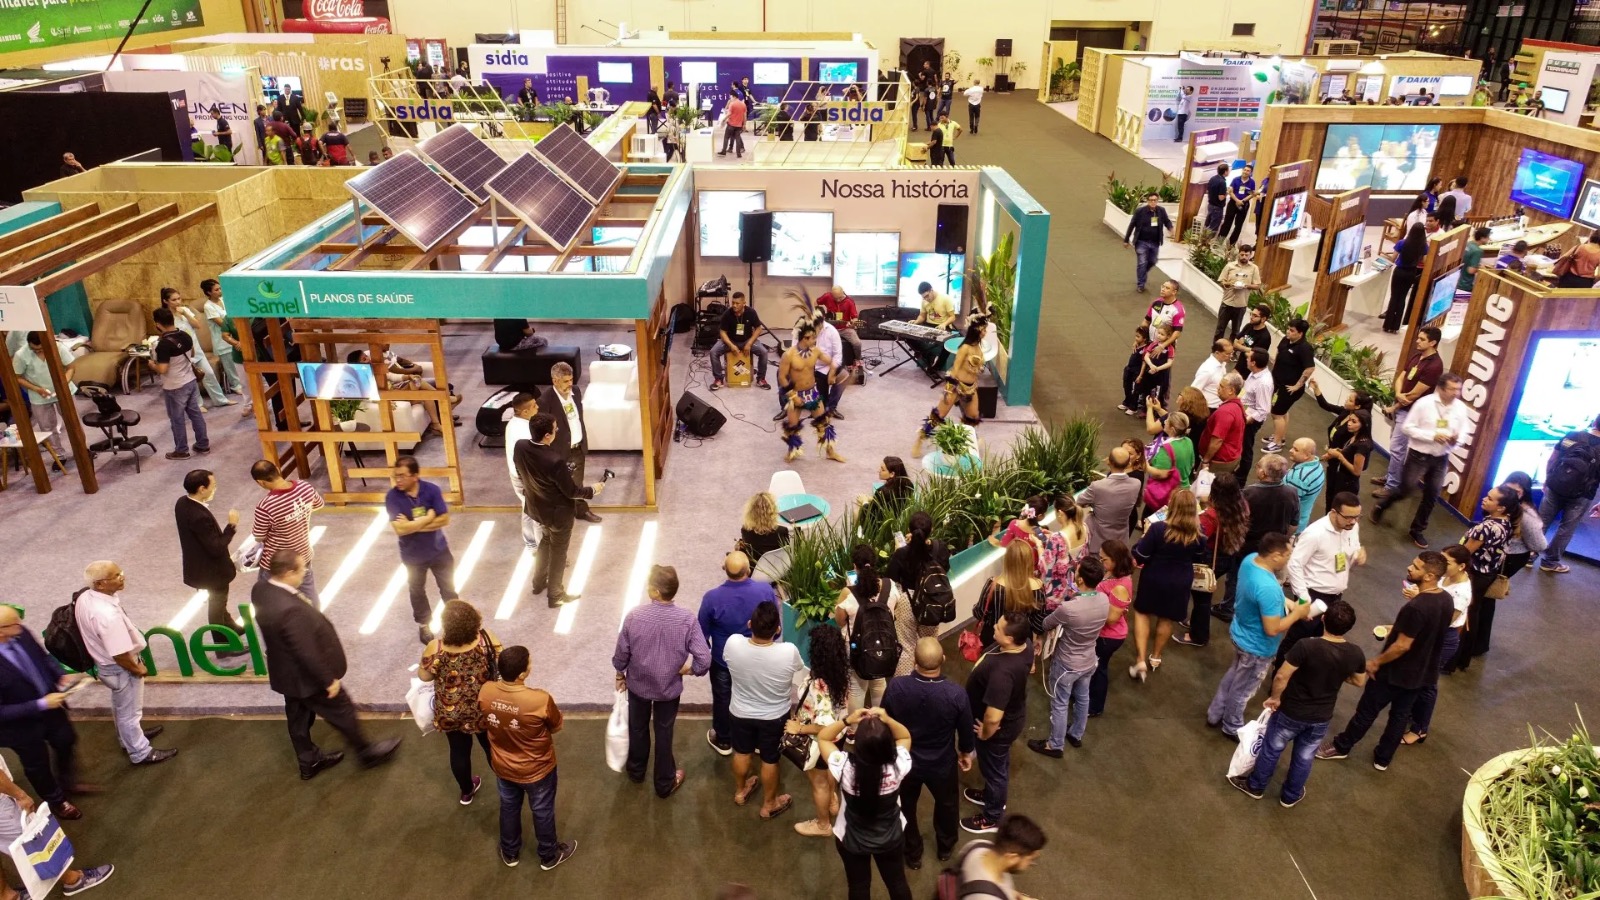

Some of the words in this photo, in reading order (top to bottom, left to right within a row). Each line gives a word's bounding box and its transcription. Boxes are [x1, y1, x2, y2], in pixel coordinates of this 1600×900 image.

[485, 50, 529, 66] sidia
[395, 99, 452, 119] sidia
[828, 102, 883, 122] sidia
[1196, 134, 1217, 144] SAMSUNG
[1278, 169, 1299, 181] SAMSUNG
[820, 179, 885, 198] Nossa
[892, 178, 969, 198] história
[248, 297, 300, 314] Samel
[310, 293, 354, 303] PLANOS
[358, 294, 373, 303] DE
[377, 292, 414, 304] SAÚDE
